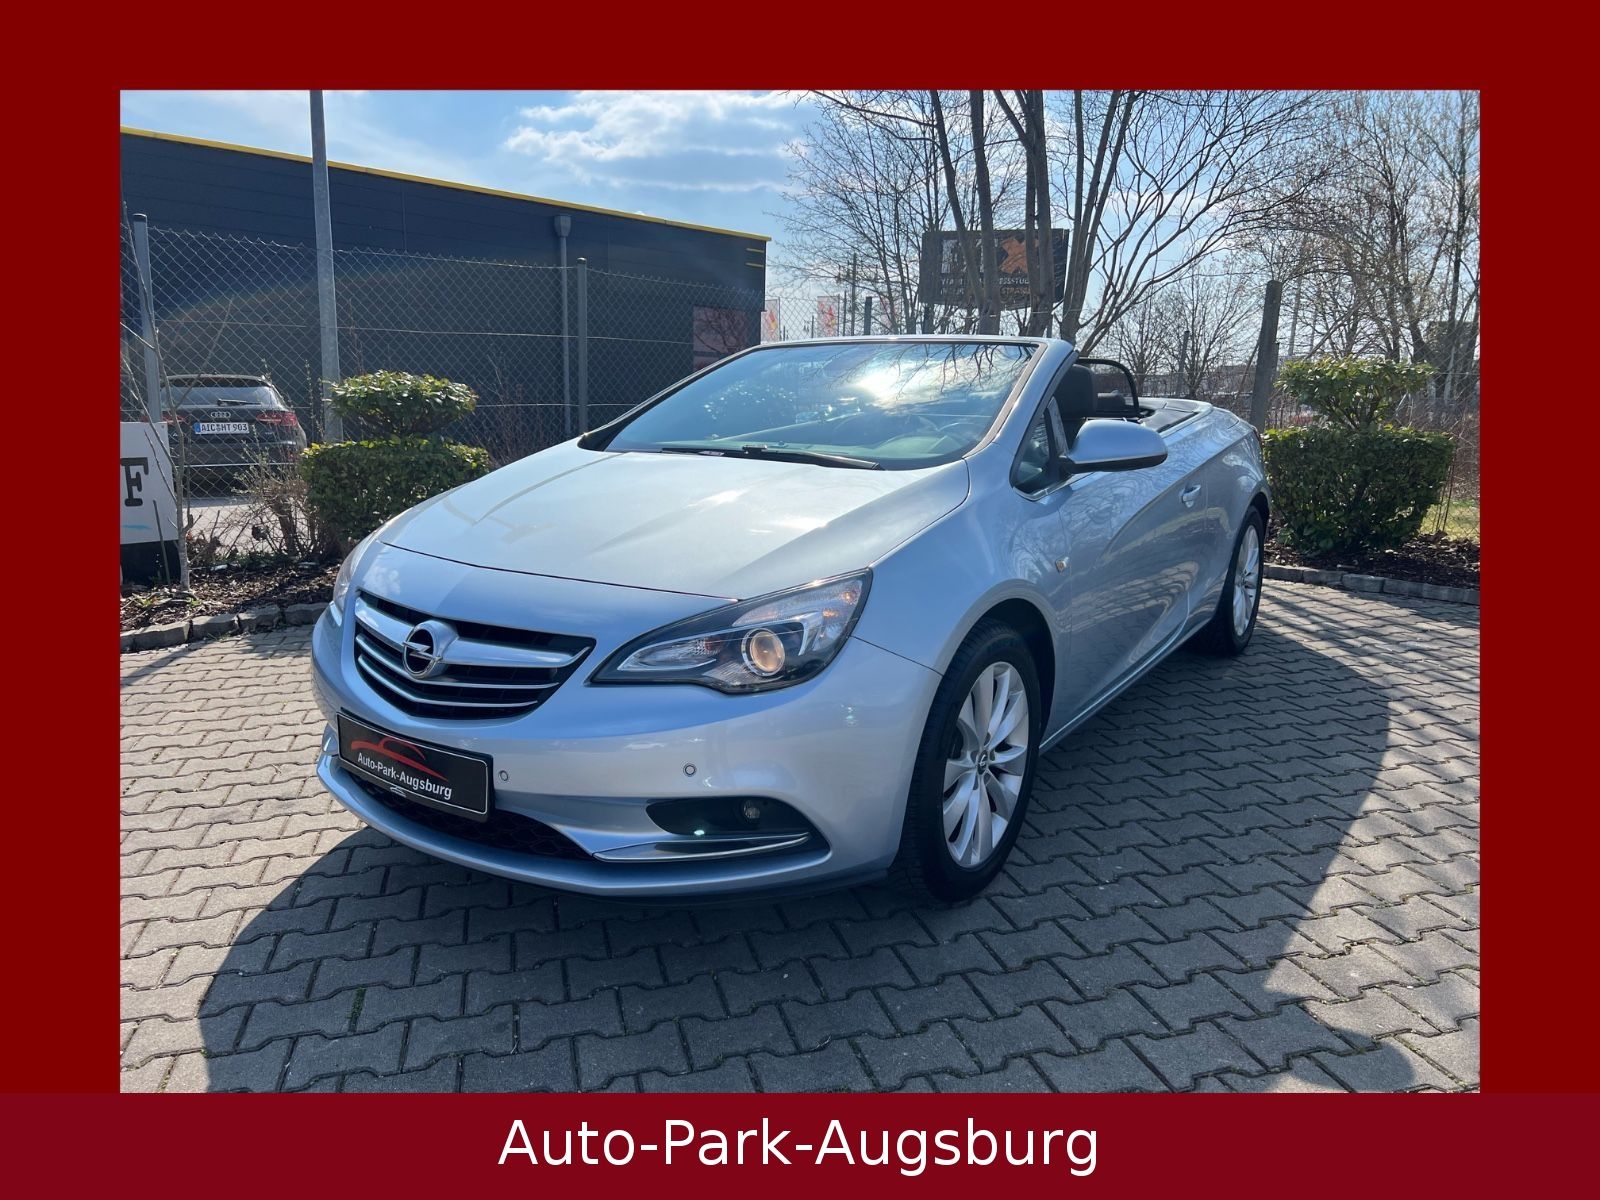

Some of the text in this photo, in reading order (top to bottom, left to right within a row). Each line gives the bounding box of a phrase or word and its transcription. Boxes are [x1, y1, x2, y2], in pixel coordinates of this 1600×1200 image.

[201, 423, 216, 432] AIC
[232, 423, 248, 432] 903
[357, 752, 453, 801] Auto-Park-Augsburg
